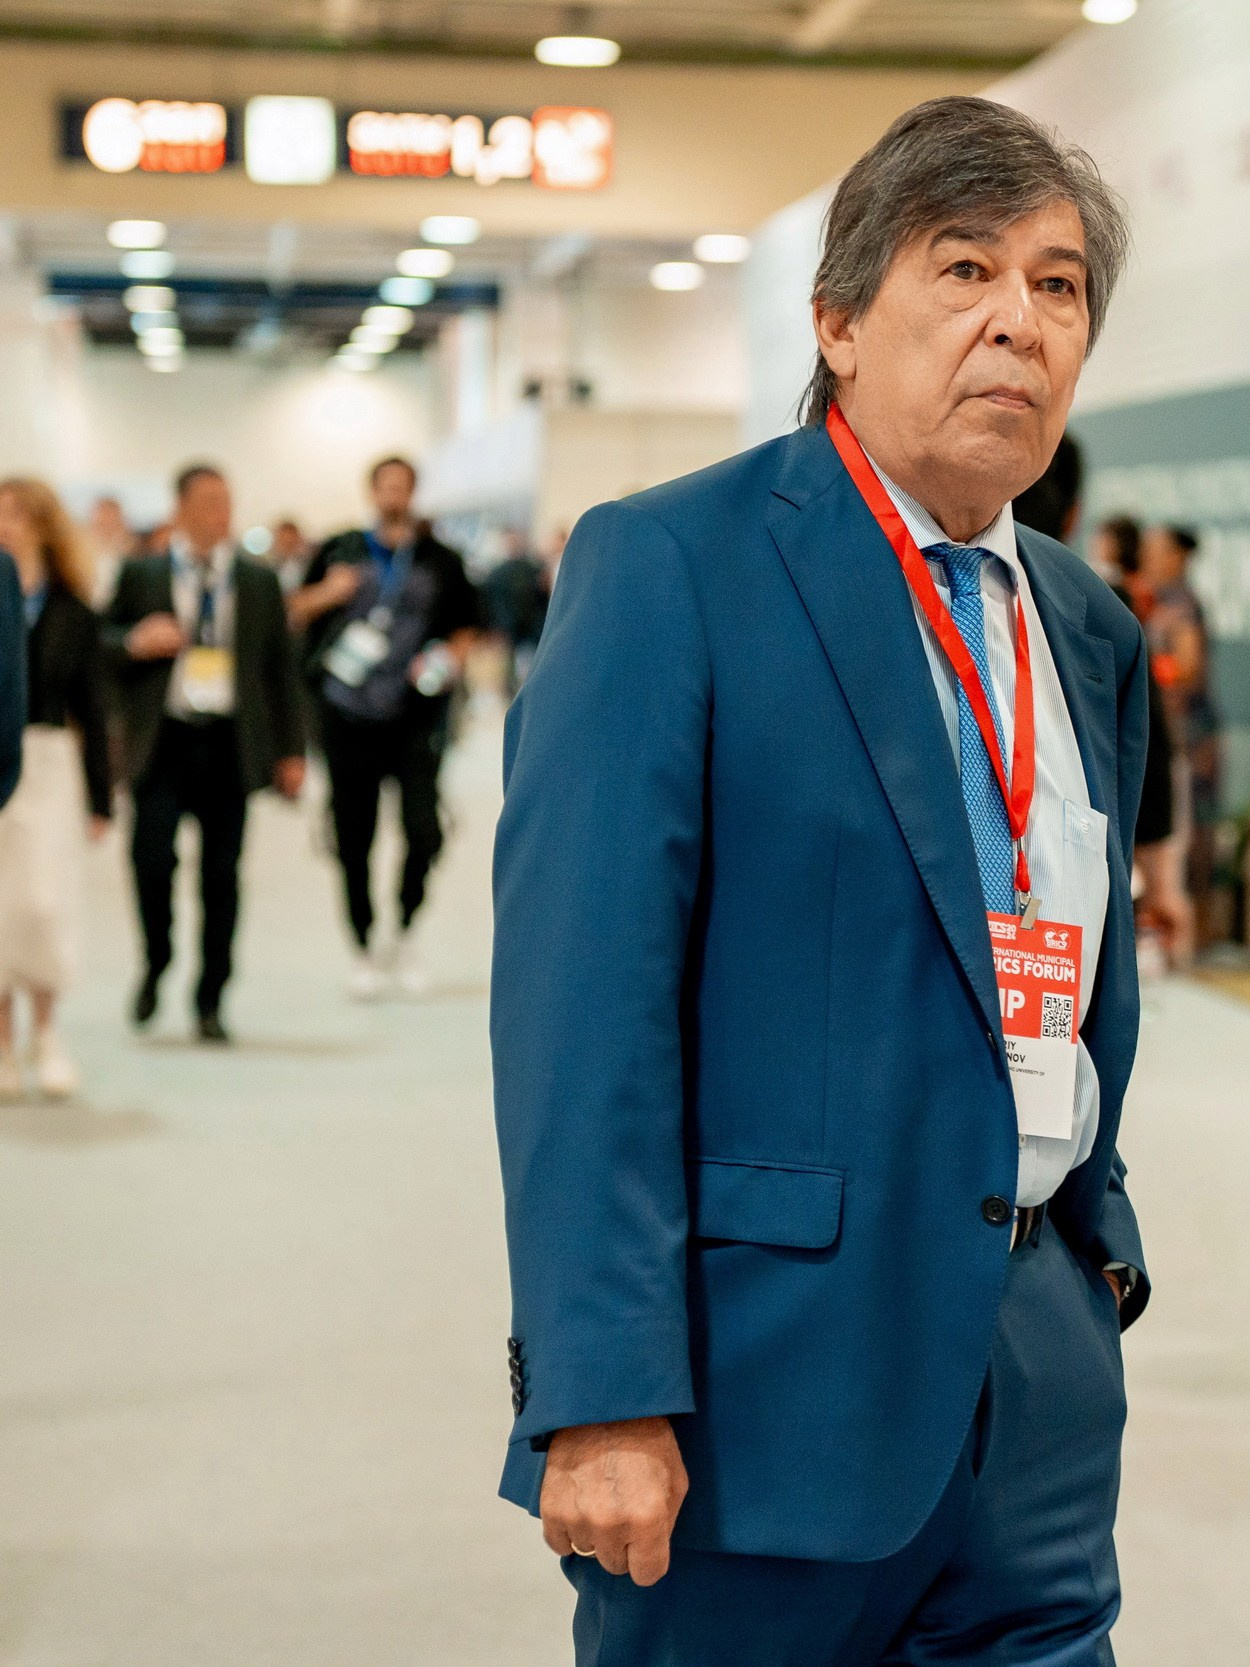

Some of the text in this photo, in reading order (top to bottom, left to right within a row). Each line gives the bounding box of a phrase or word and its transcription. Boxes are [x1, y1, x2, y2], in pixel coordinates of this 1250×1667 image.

[992, 947, 1076, 968] RNATIONAL MUNICIPAL
[1023, 960, 1076, 984] FORUM
[999, 988, 1026, 1019] IP
[1006, 1052, 1026, 1064] NOV
